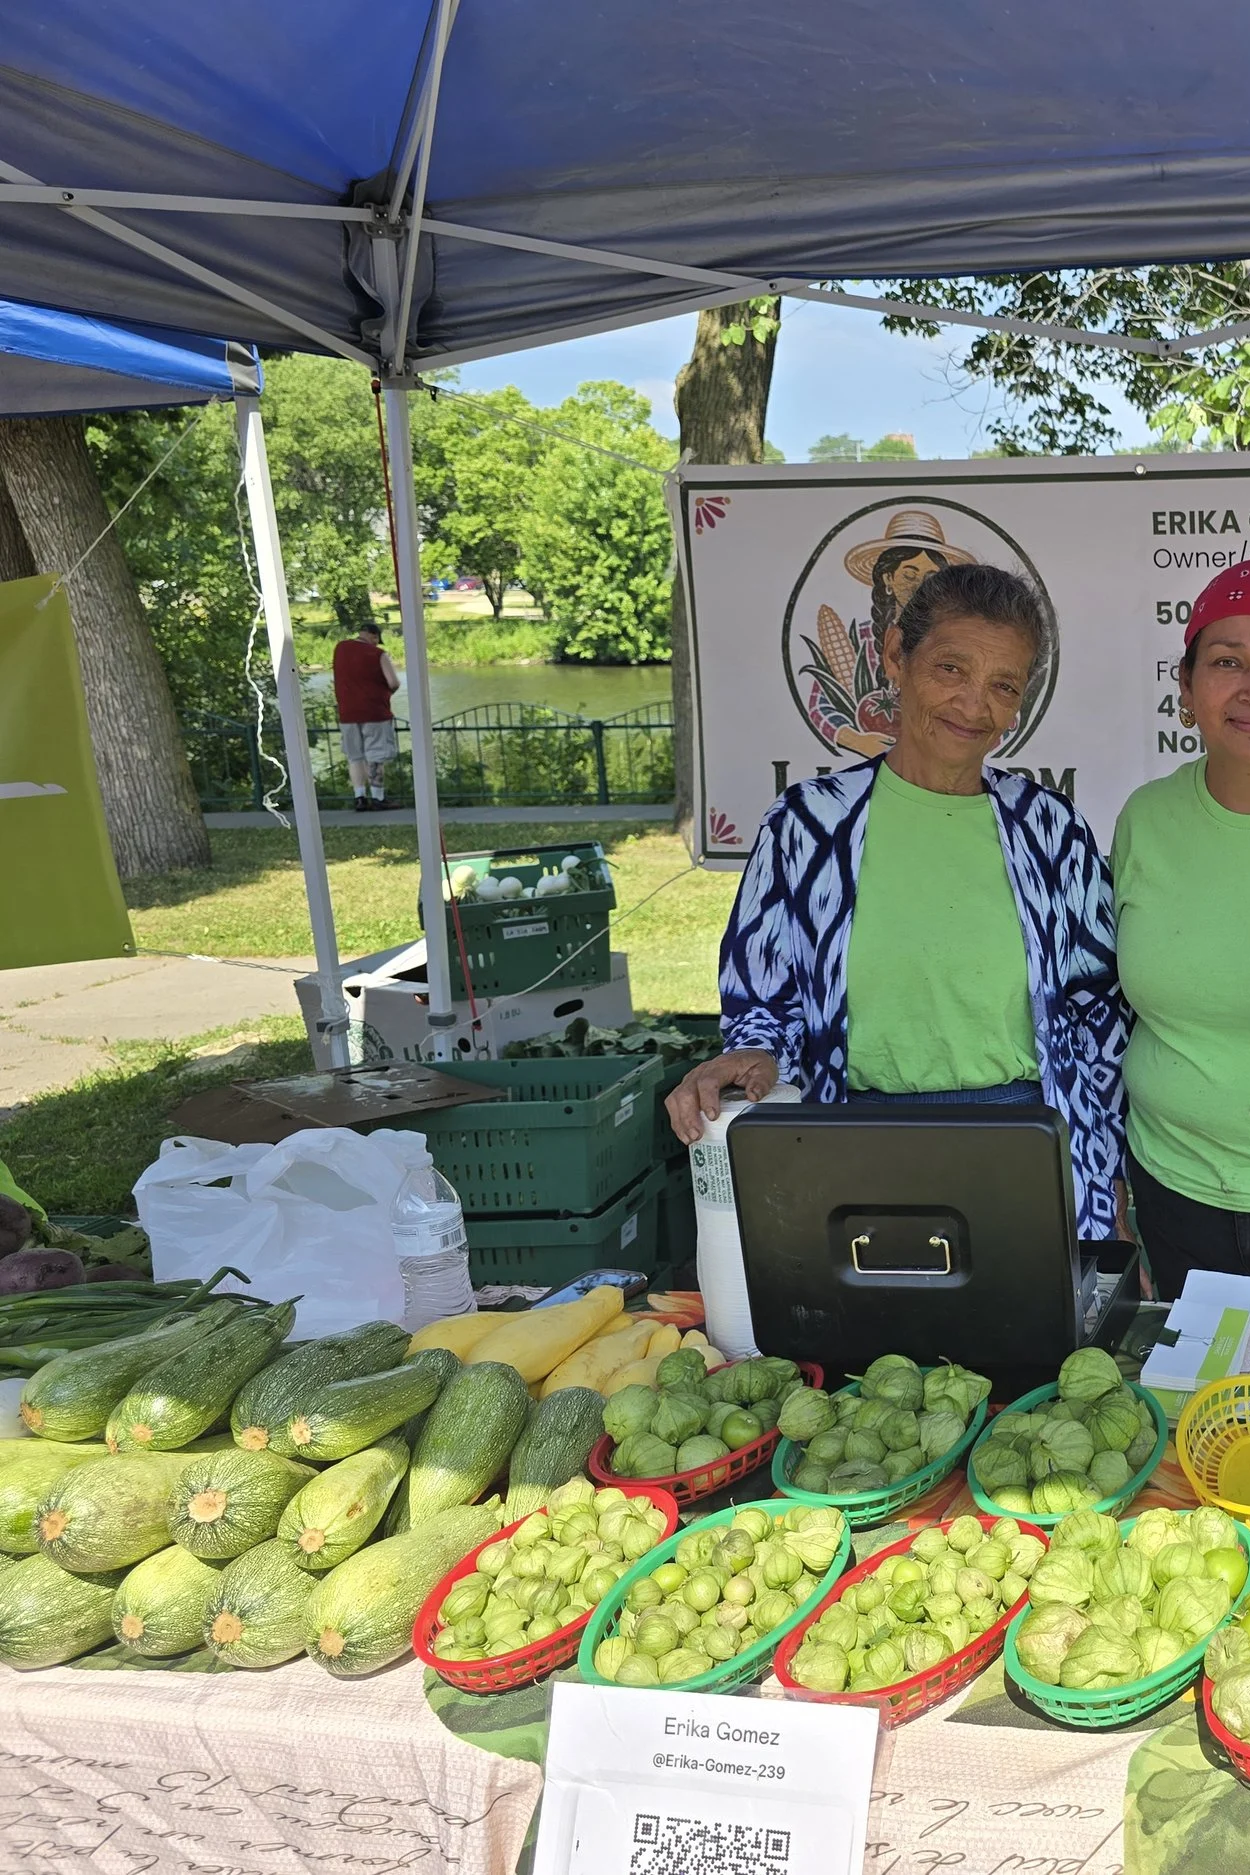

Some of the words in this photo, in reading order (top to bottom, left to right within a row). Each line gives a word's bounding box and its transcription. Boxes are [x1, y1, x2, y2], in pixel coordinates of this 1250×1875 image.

[1152, 509, 1241, 535] ERIKA
[664, 1716, 710, 1739] Erika
[716, 1721, 781, 1746] Gomez
[0, 1752, 133, 1770] minu
[652, 1752, 786, 1780] @Erika-Gomez-239
[918, 1798, 970, 1840] le
[987, 1801, 1105, 1820] avec
